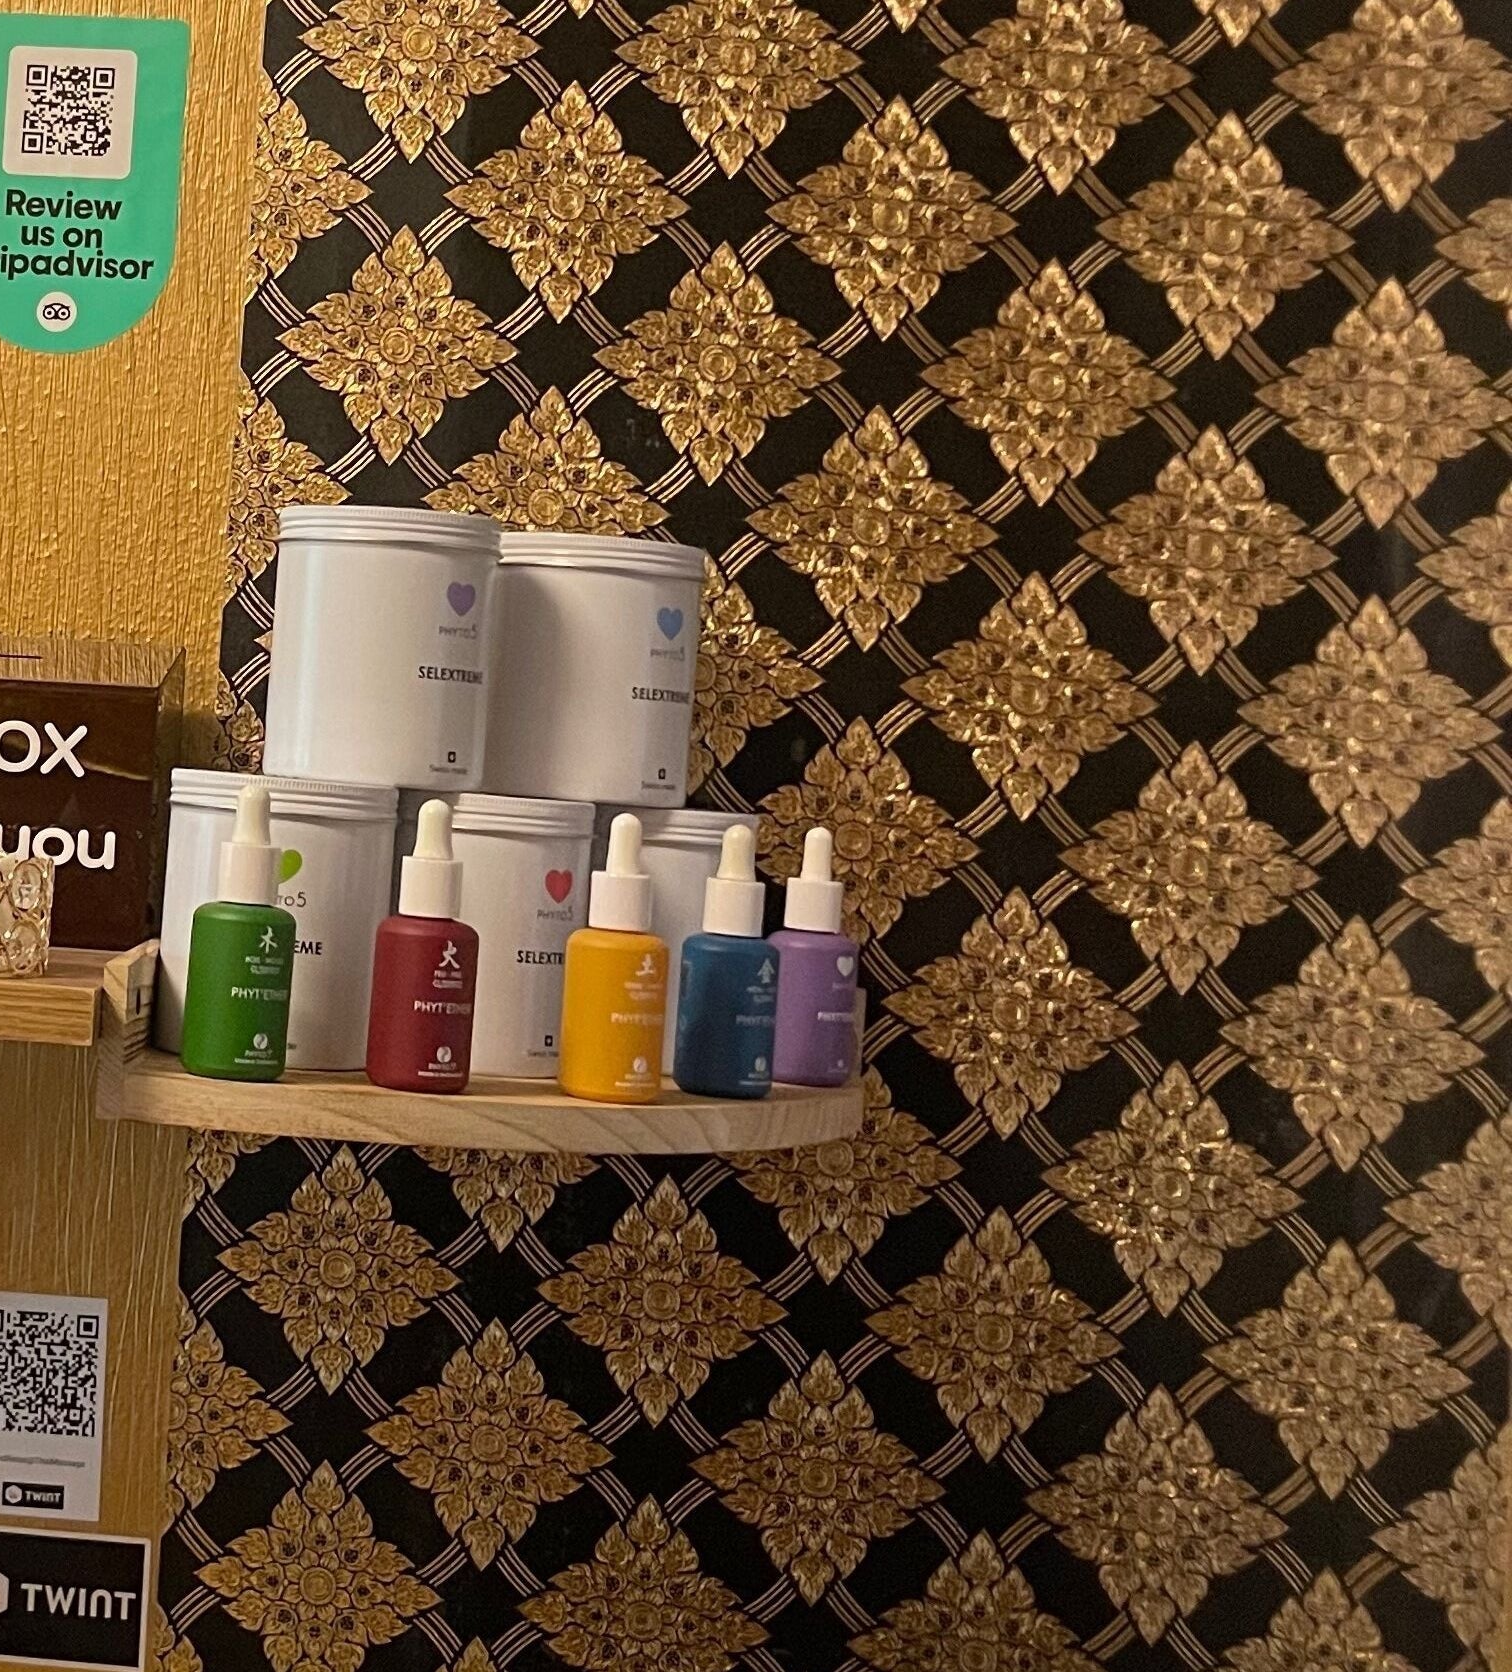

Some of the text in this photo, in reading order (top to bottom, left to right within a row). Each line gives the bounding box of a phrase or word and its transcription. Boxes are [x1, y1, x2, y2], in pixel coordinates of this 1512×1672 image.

[5, 188, 123, 221] Review
[21, 224, 103, 249] us on
[25, 1490, 62, 1503] TWINT
[20, 1582, 137, 1621] TWINT
